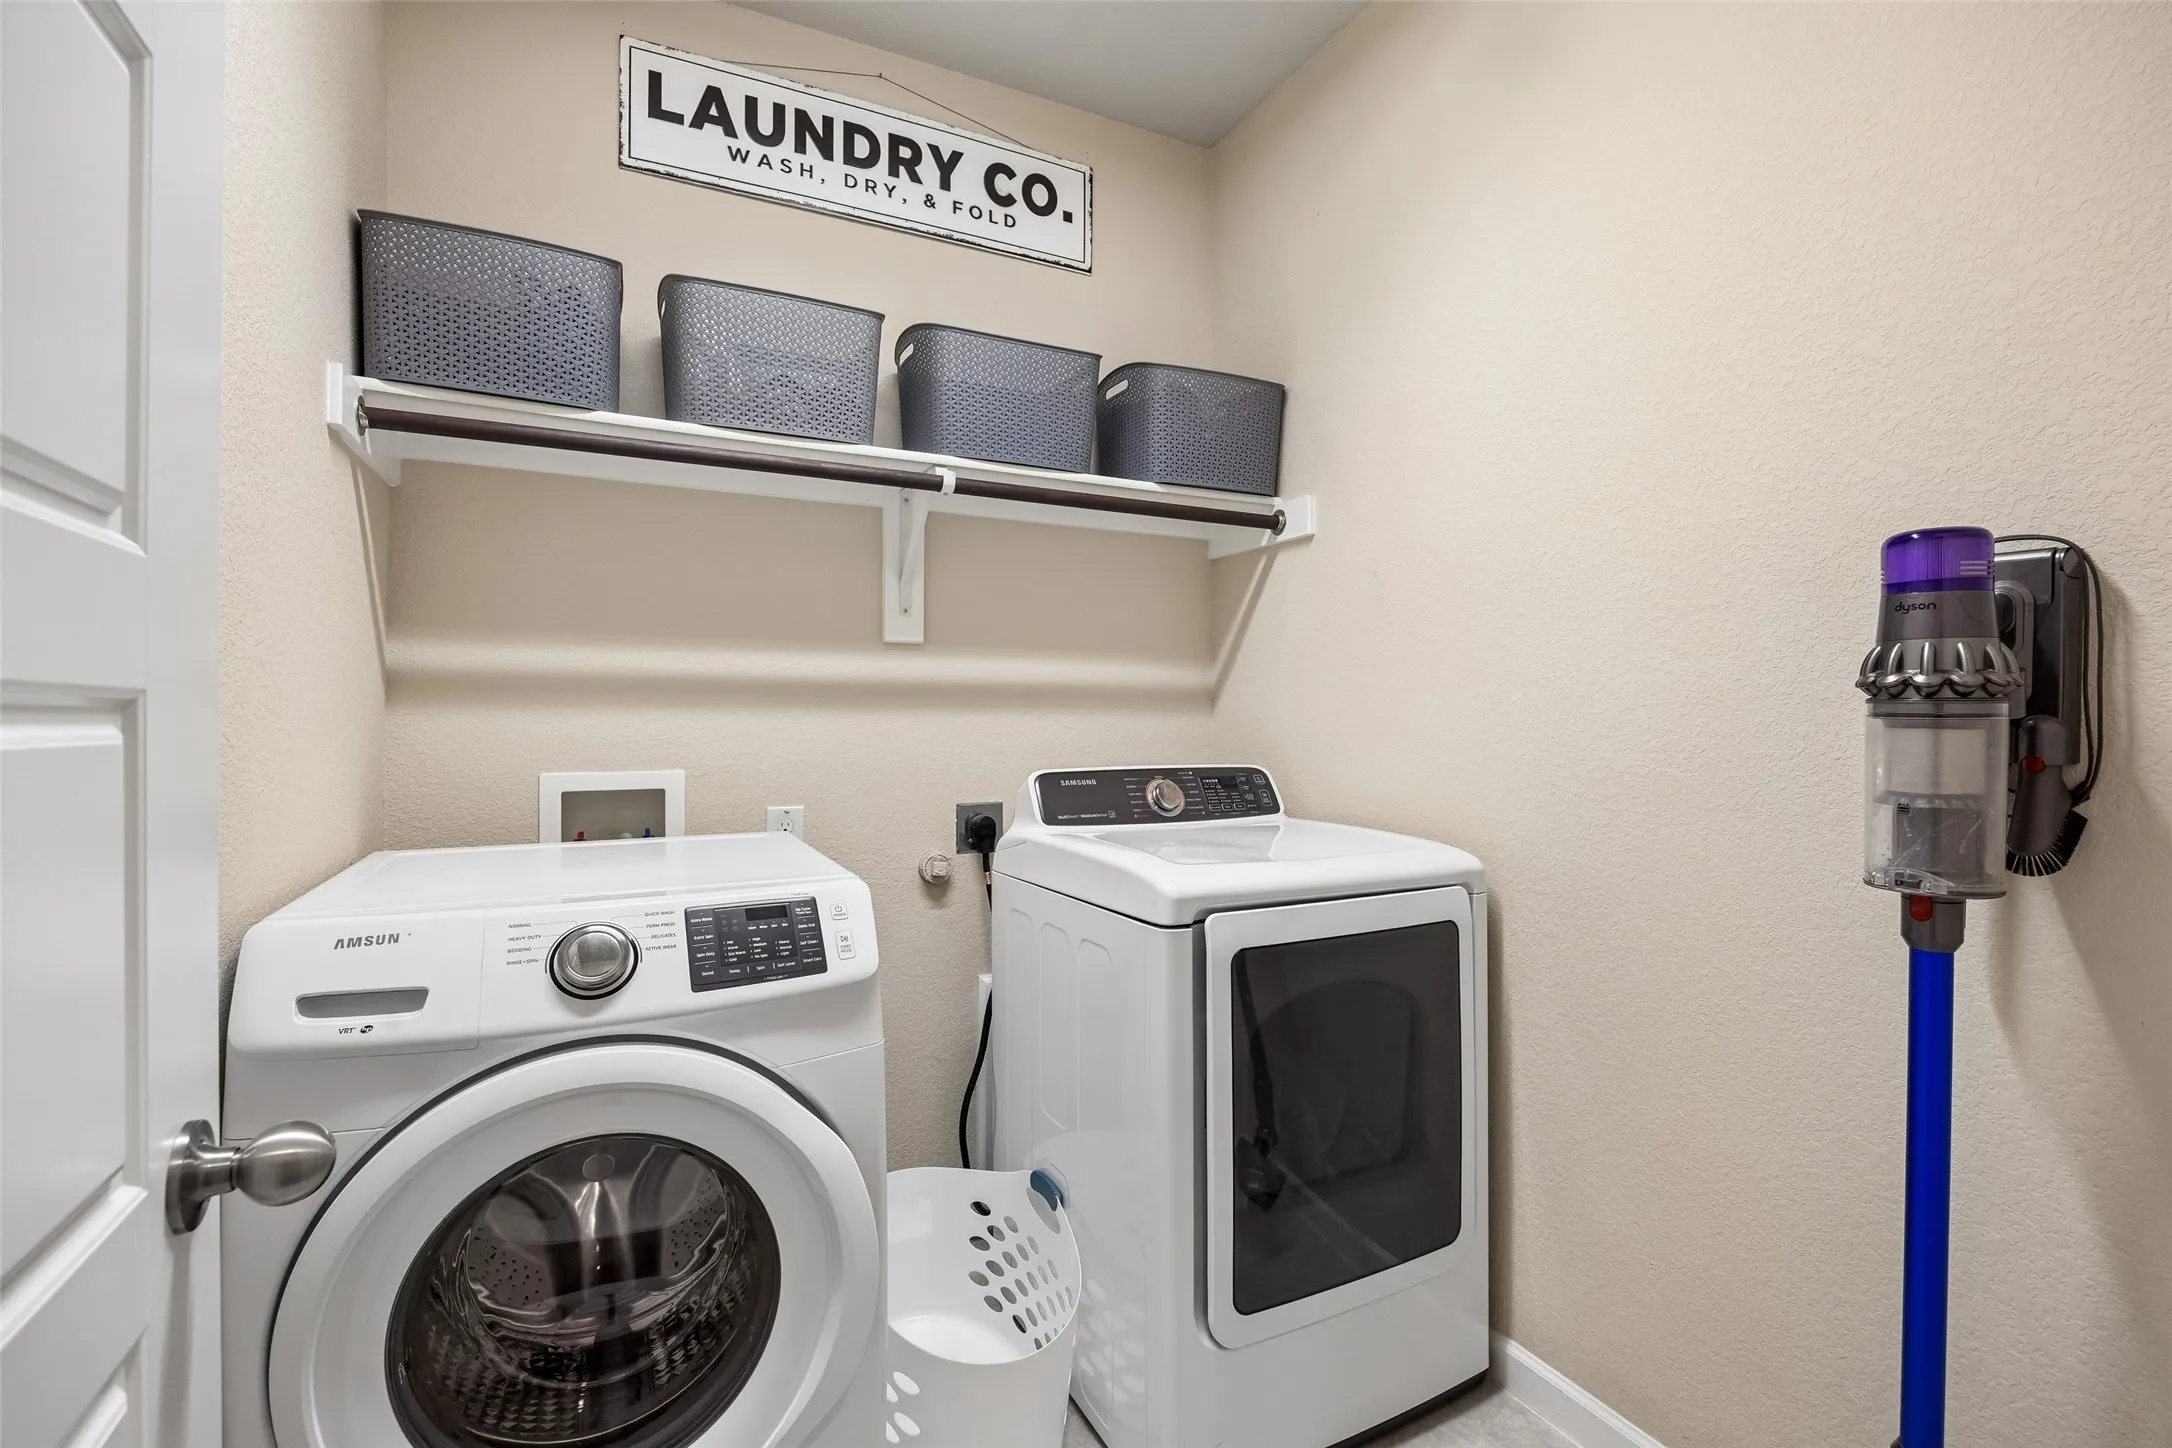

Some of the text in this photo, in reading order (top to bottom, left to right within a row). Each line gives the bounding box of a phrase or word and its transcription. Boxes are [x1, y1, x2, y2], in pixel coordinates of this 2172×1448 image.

[647, 69, 1073, 224] LAUNDRY CO.
[727, 145, 1017, 229] WASH, DRY, & FOLD
[1894, 601, 1937, 615] dyson
[1060, 778, 1097, 787] SAMSUNG
[650, 932, 677, 940] DELICATES
